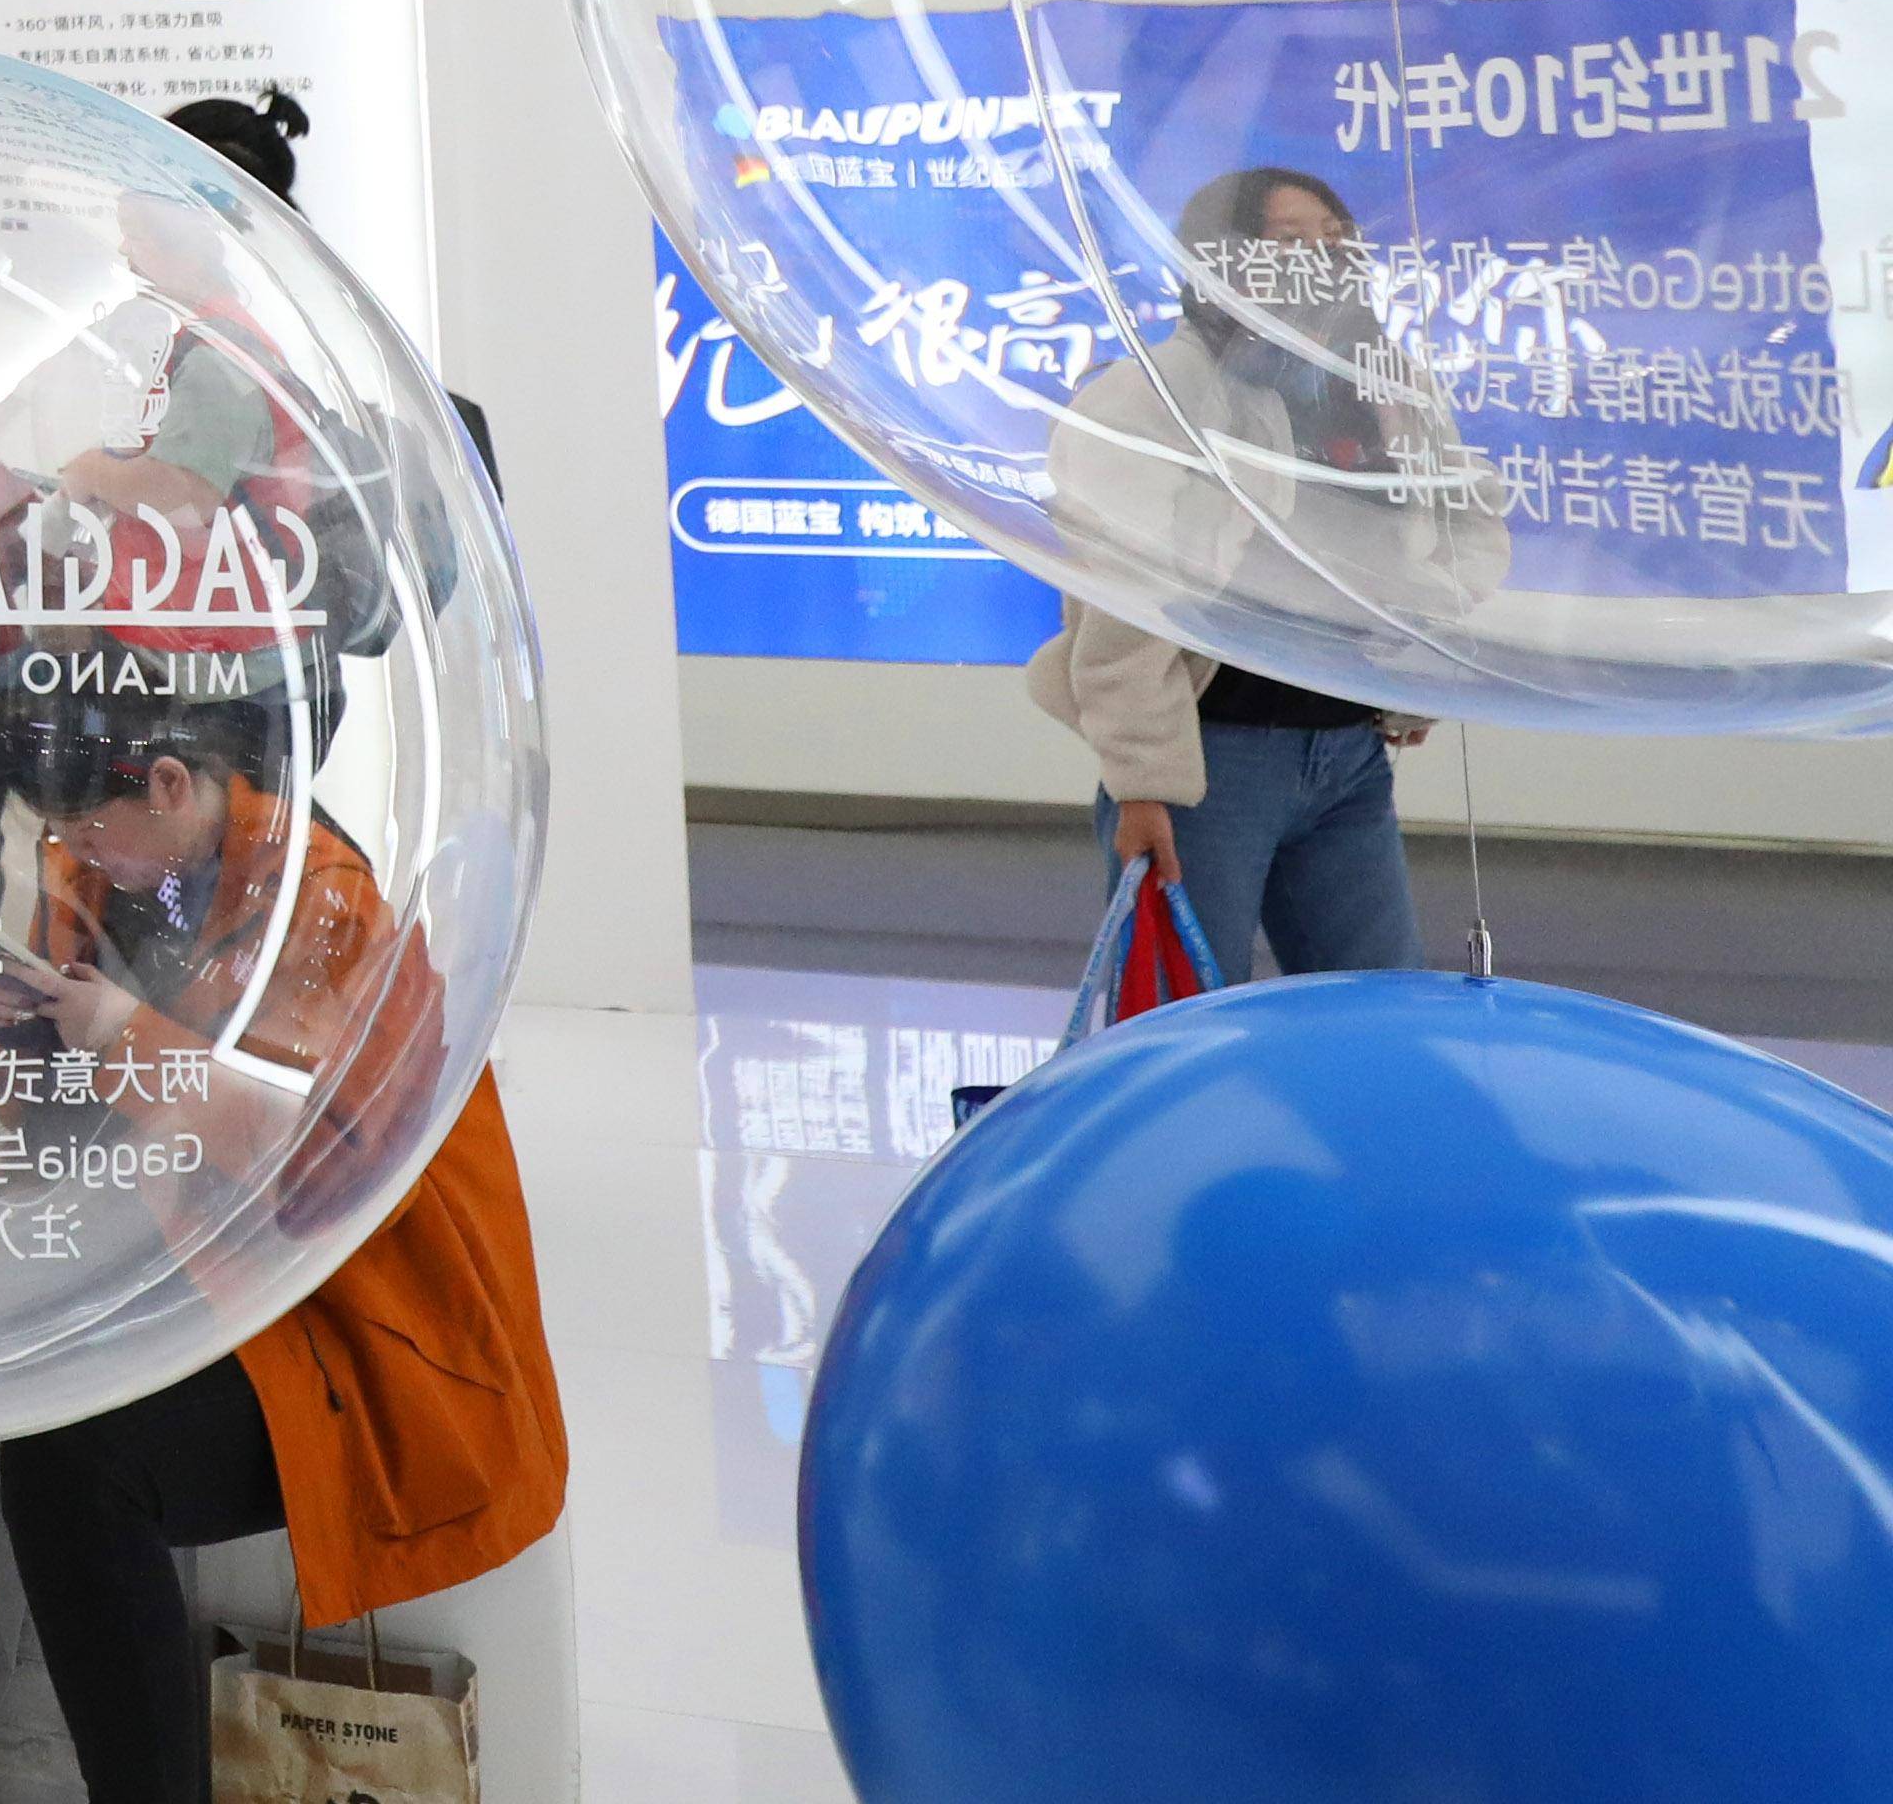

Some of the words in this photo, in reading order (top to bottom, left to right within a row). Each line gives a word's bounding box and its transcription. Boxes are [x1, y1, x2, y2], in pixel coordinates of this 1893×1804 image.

[704, 498, 843, 537] 德国蓝宝
[280, 1712, 336, 1736] PAPER
[342, 1721, 399, 1744] STONE
